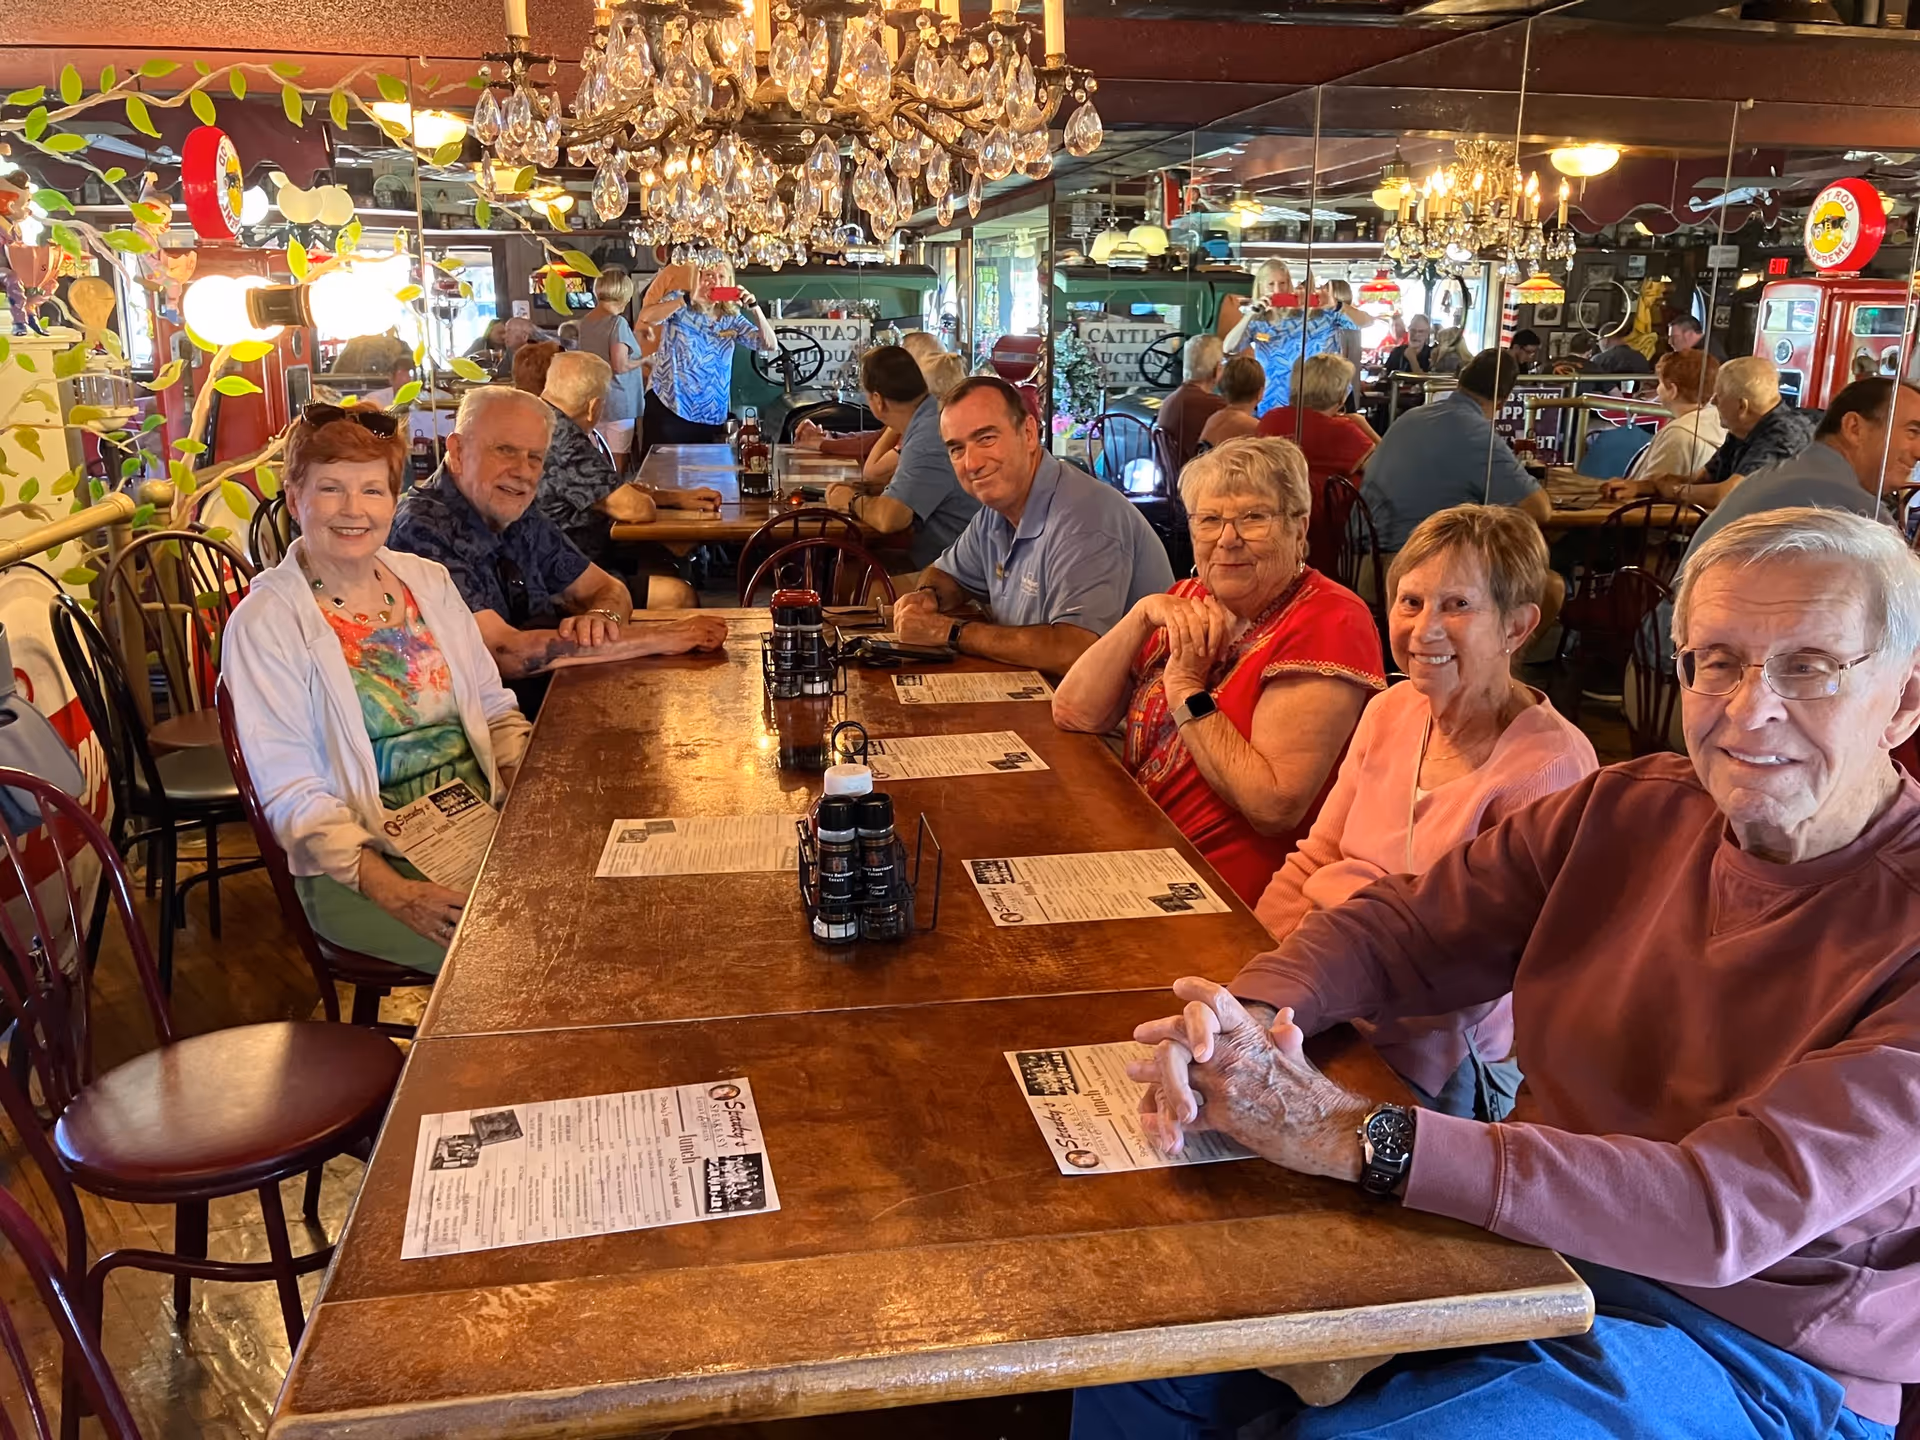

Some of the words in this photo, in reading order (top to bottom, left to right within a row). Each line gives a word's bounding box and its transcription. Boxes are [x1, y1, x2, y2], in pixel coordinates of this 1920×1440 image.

[1812, 191, 1833, 216] HOT
[1834, 190, 1855, 212] ROD
[1769, 257, 1789, 275] EXIT
[1807, 240, 1852, 265] SUPREME
[1087, 328, 1167, 343] CATTLE
[1090, 352, 1164, 365] AUCTION
[1083, 1089, 1112, 1117] lunch
[710, 1103, 728, 1149] SPEAKEASY
[722, 1100, 756, 1148] Spanky's
[1036, 1102, 1078, 1149] Spanky's
[1063, 1102, 1093, 1147] SPEAKEASY
[678, 1134, 702, 1164] lunch
